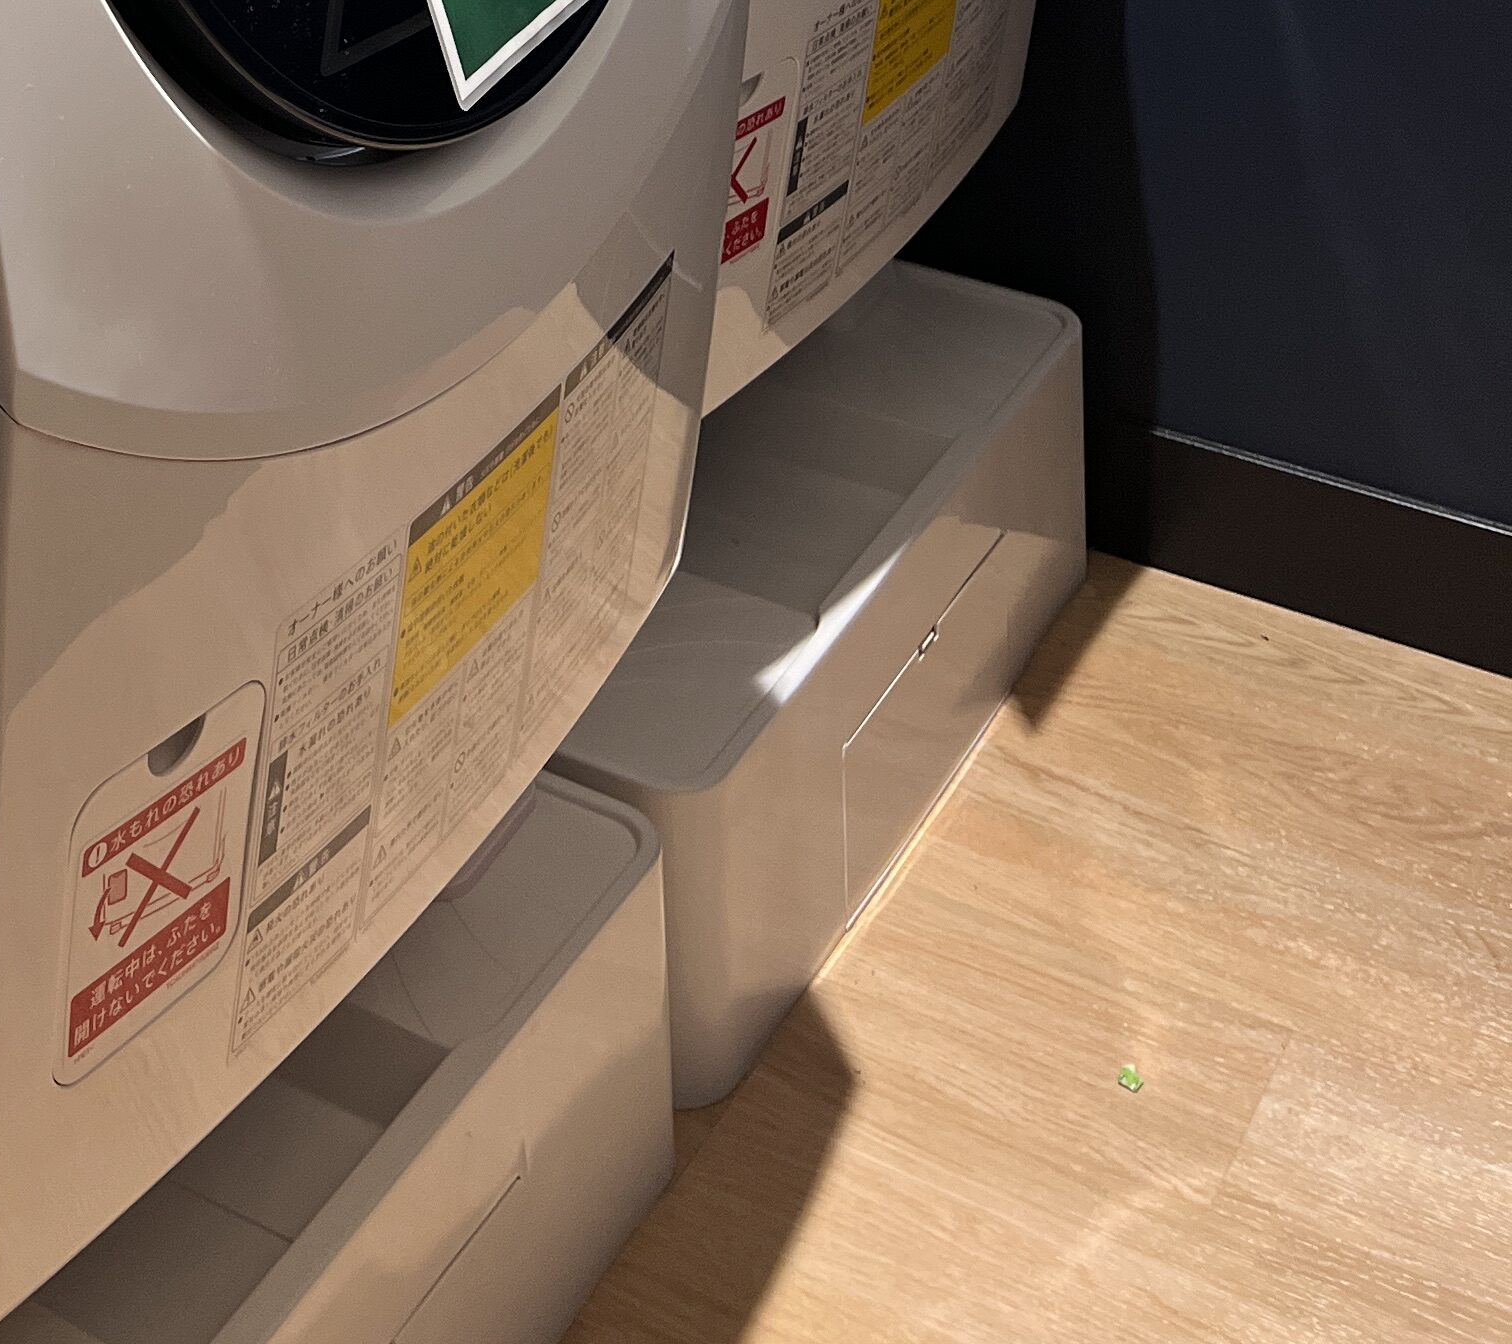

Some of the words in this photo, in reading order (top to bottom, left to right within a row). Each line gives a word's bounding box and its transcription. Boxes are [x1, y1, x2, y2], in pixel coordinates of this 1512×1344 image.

[288, 539, 397, 636] オーナー様へのお願い
[110, 743, 243, 853] 水もれの恐れあり
[73, 923, 223, 1048] 開けないでください。
[88, 898, 214, 1009] 運転中は、ふたを
